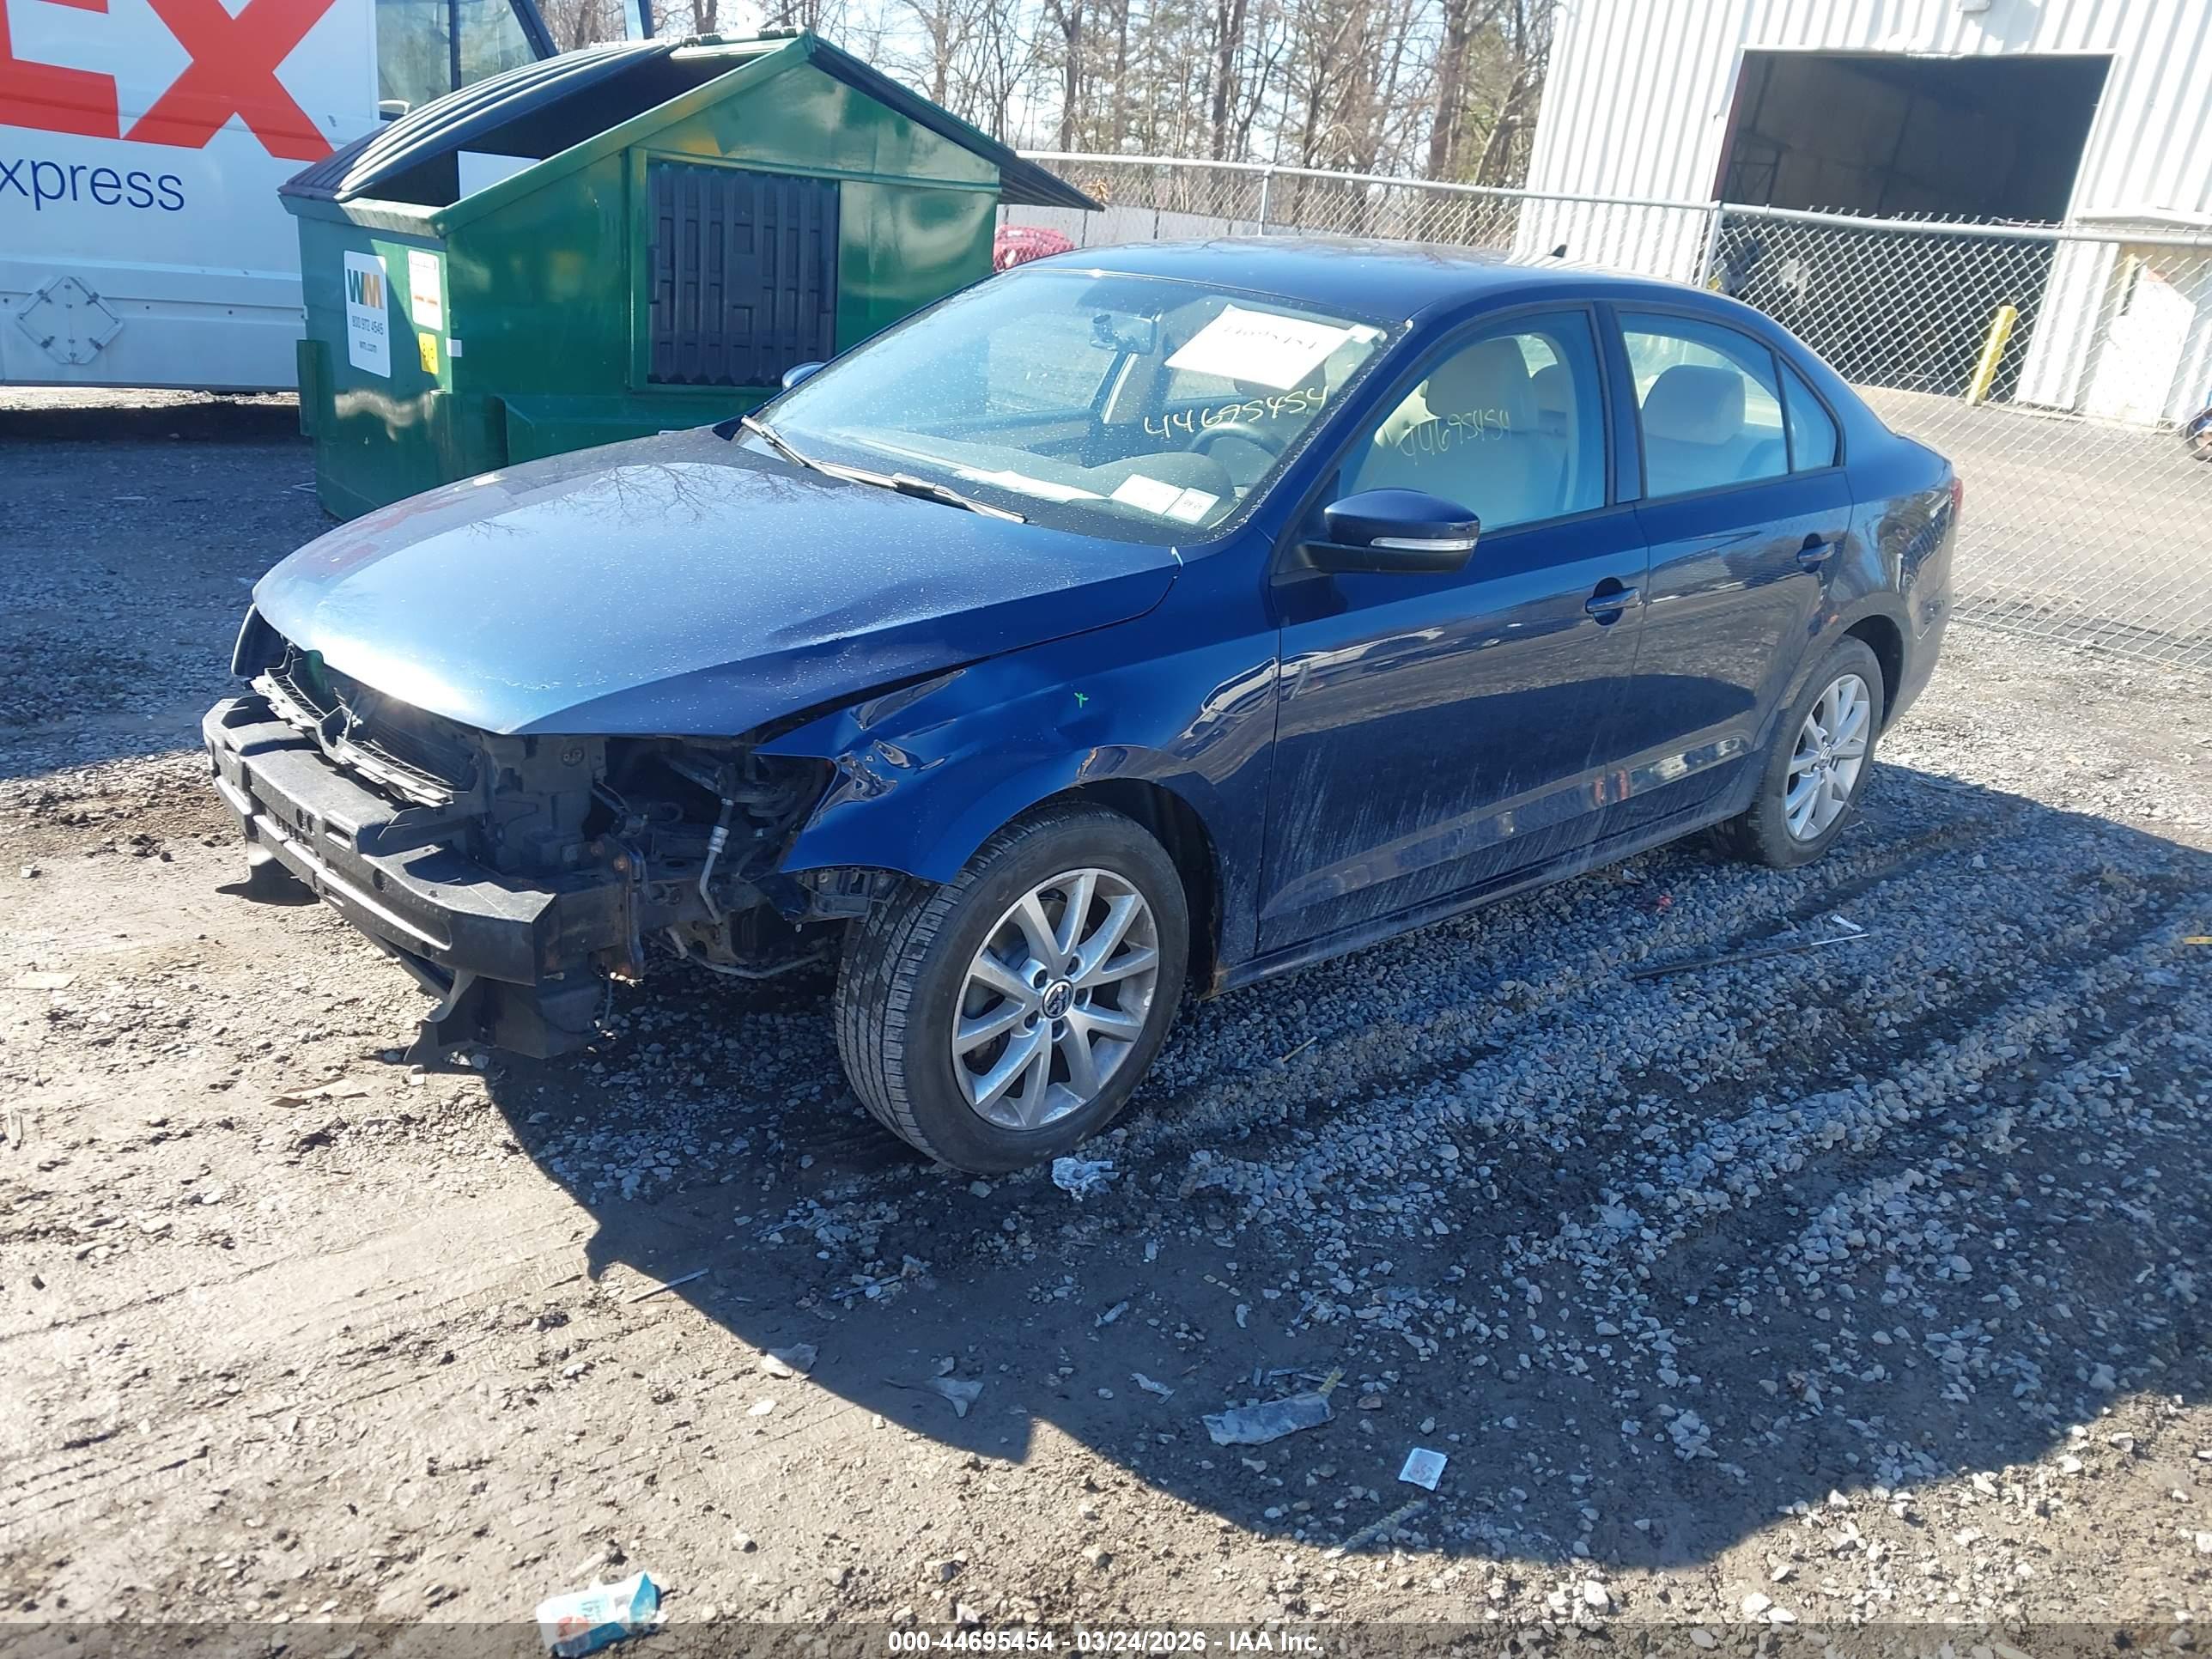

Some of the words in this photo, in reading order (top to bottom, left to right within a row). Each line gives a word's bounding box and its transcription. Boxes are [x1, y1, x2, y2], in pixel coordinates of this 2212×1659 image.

[347, 268, 384, 310] WM
[1144, 386, 1329, 439] 44695454
[1400, 409, 1511, 466] 44695454
